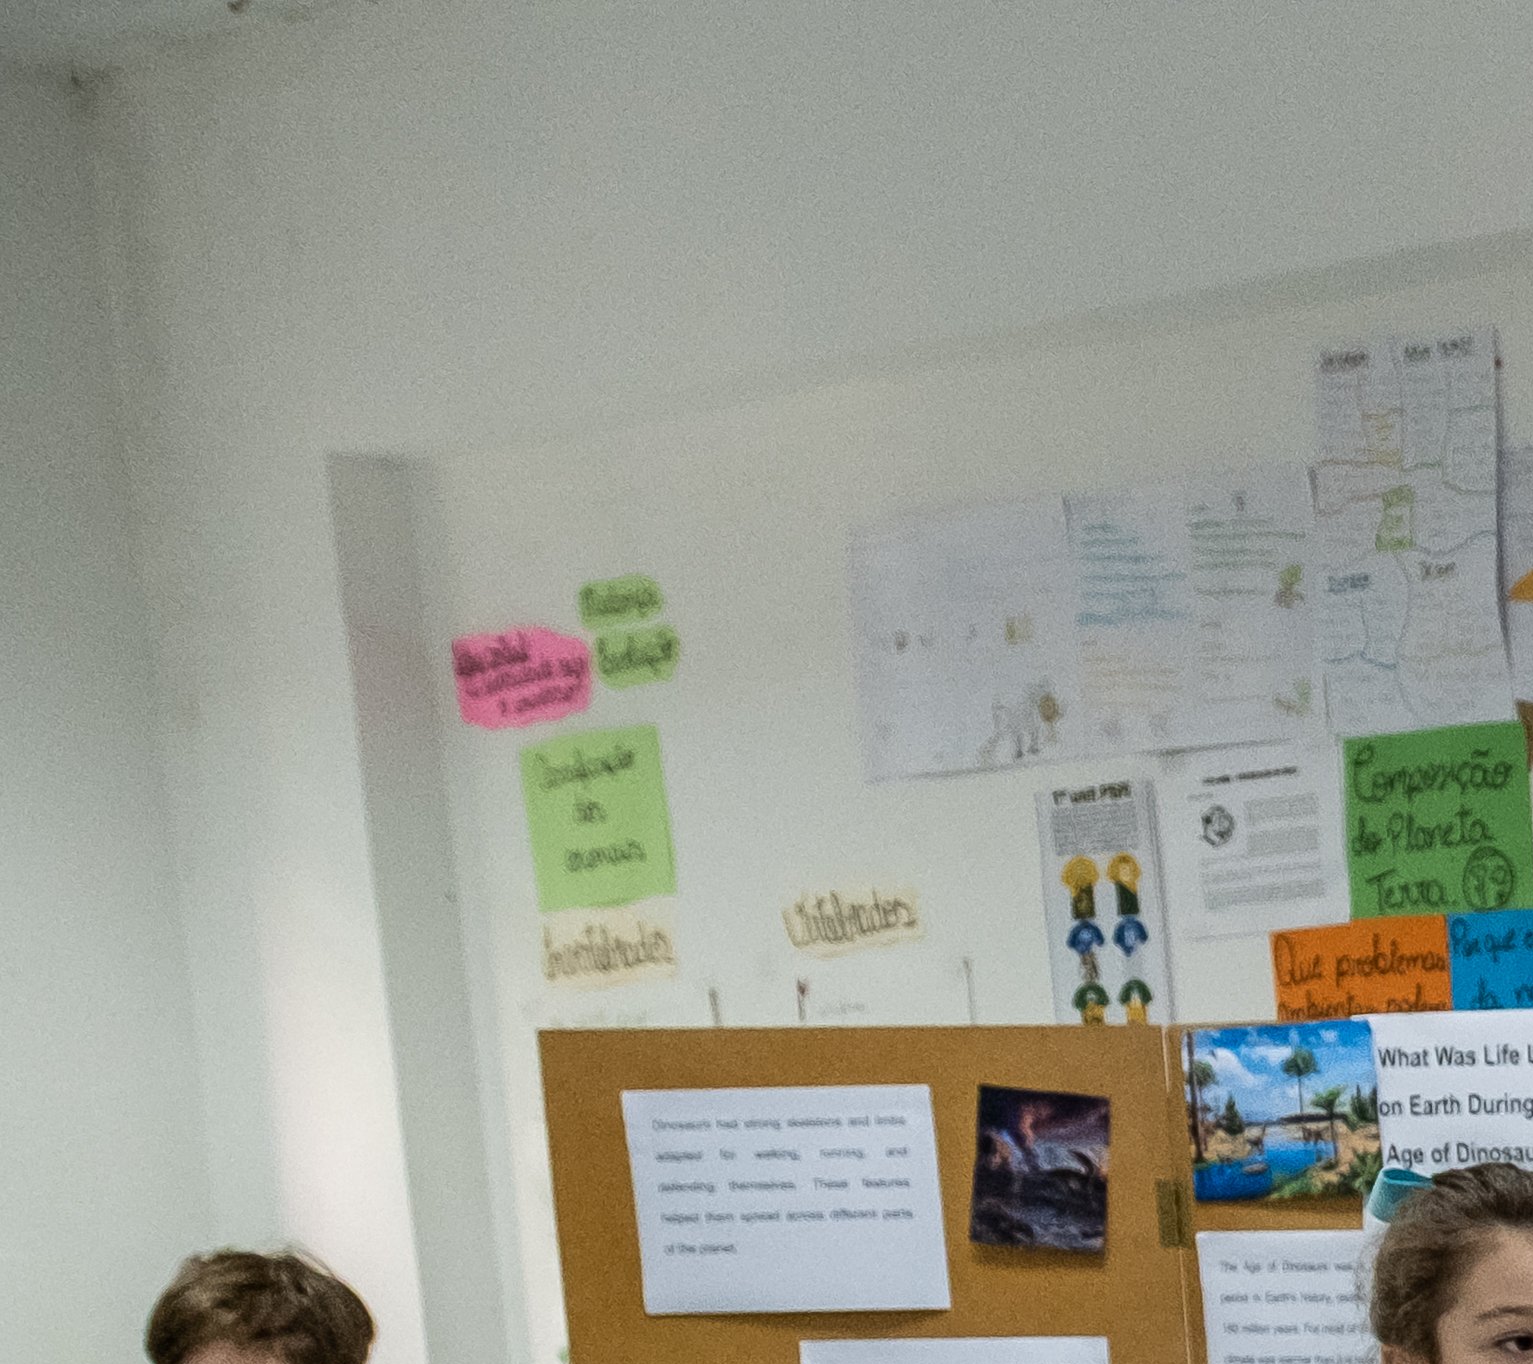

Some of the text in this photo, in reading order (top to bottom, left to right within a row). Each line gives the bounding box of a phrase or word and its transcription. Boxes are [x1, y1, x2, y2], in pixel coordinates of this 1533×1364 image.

[1378, 1048, 1429, 1068] What
[1435, 1046, 1476, 1067] Was
[1484, 1044, 1520, 1067] Life
[1380, 1103, 1402, 1116] on
[1409, 1095, 1461, 1117] Earth
[1386, 1144, 1424, 1170] Age
[1431, 1143, 1450, 1164] of
